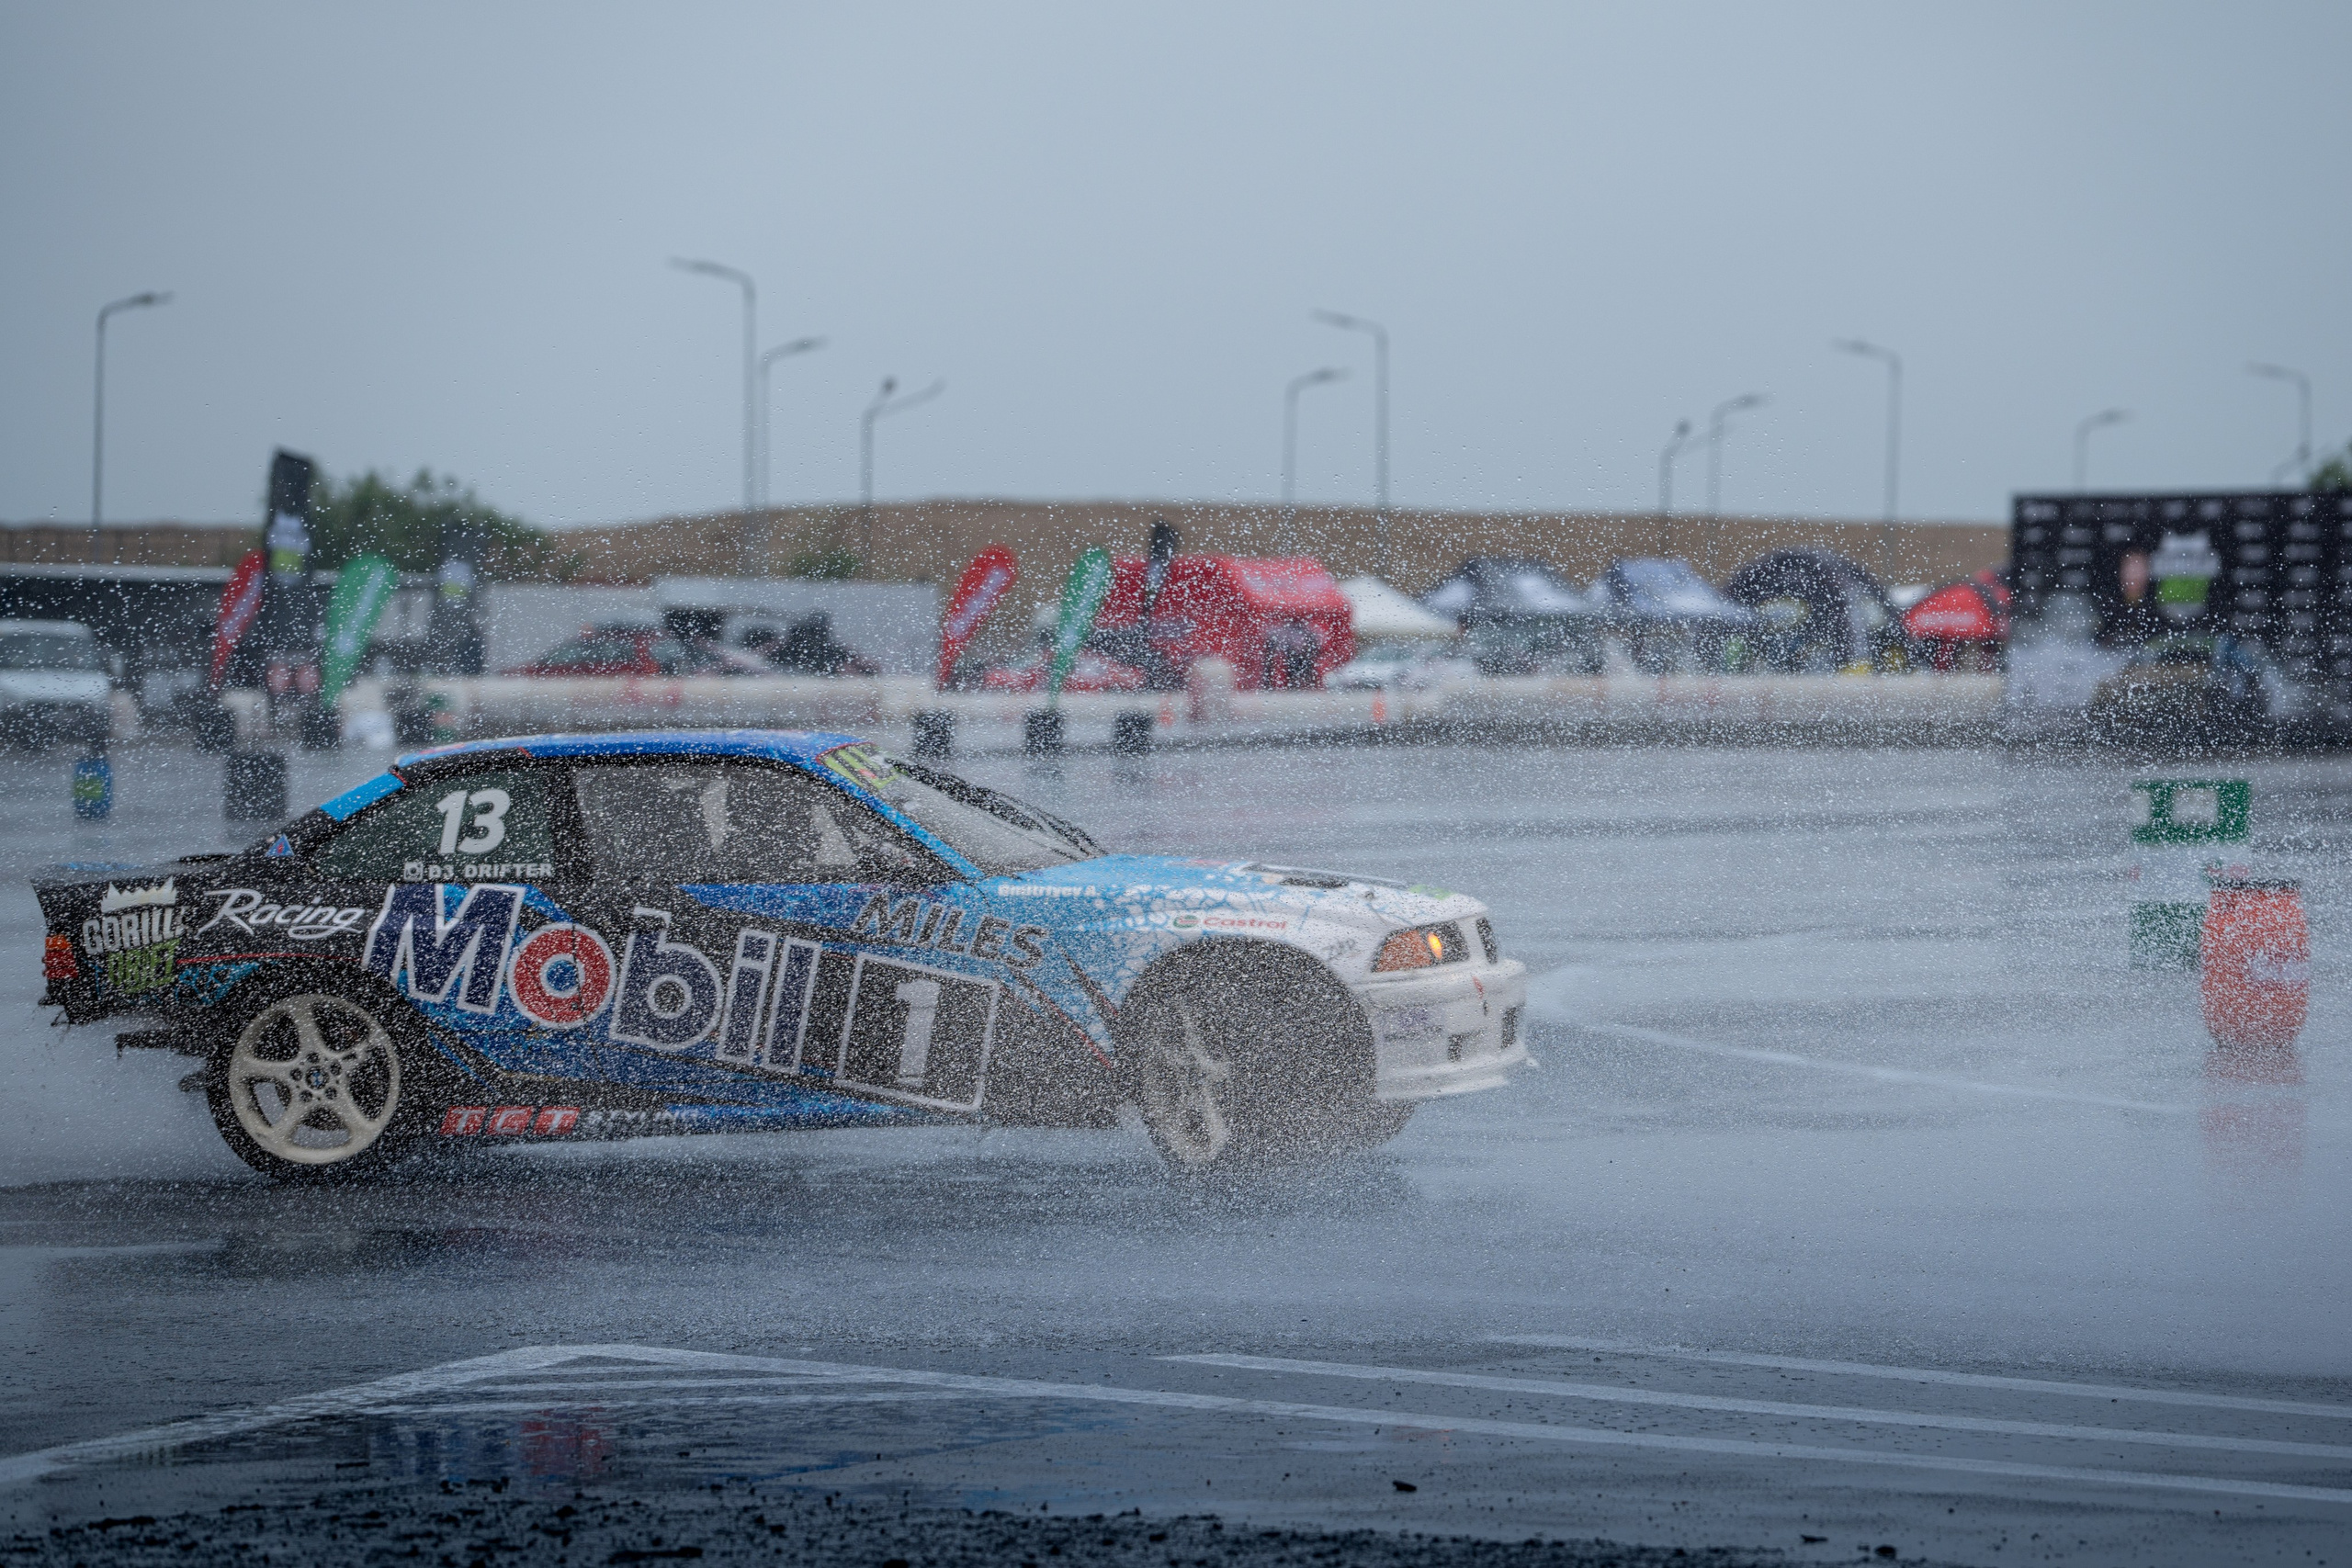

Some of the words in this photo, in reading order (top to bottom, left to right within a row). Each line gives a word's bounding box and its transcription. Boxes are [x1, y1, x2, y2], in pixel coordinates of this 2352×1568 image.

[436, 788, 511, 855] 13
[464, 863, 552, 879] DRIFTER
[194, 888, 370, 940] Racing
[850, 891, 1048, 969] MILES
[1203, 916, 1287, 931] Castrol
[362, 884, 821, 1074] Mobil
[891, 979, 940, 1087] 1
